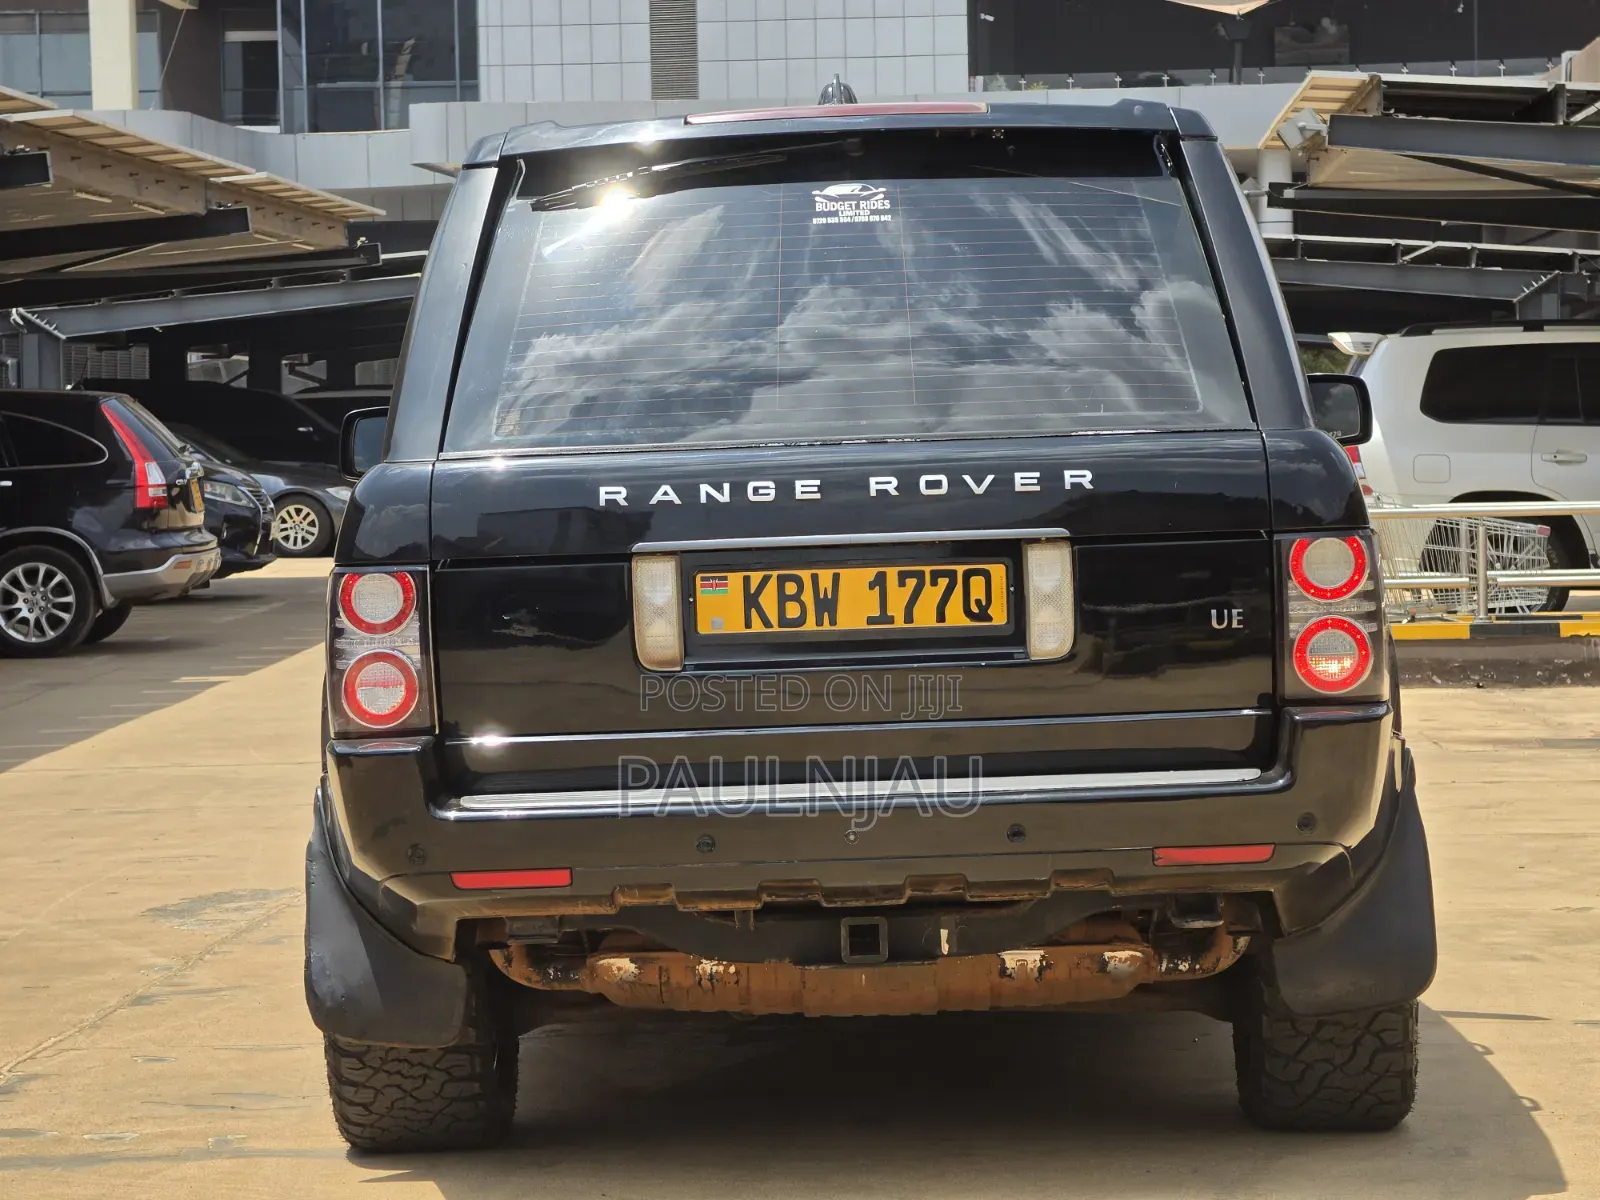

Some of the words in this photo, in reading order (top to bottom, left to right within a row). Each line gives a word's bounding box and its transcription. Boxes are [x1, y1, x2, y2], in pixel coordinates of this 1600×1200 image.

[815, 201, 857, 212] BUDGET
[860, 200, 891, 210] RIDES
[599, 479, 821, 506] RANGE
[869, 469, 1094, 497] ROVER
[742, 572, 841, 630] KBW
[866, 567, 994, 626] 177Q
[1210, 608, 1244, 630] UE
